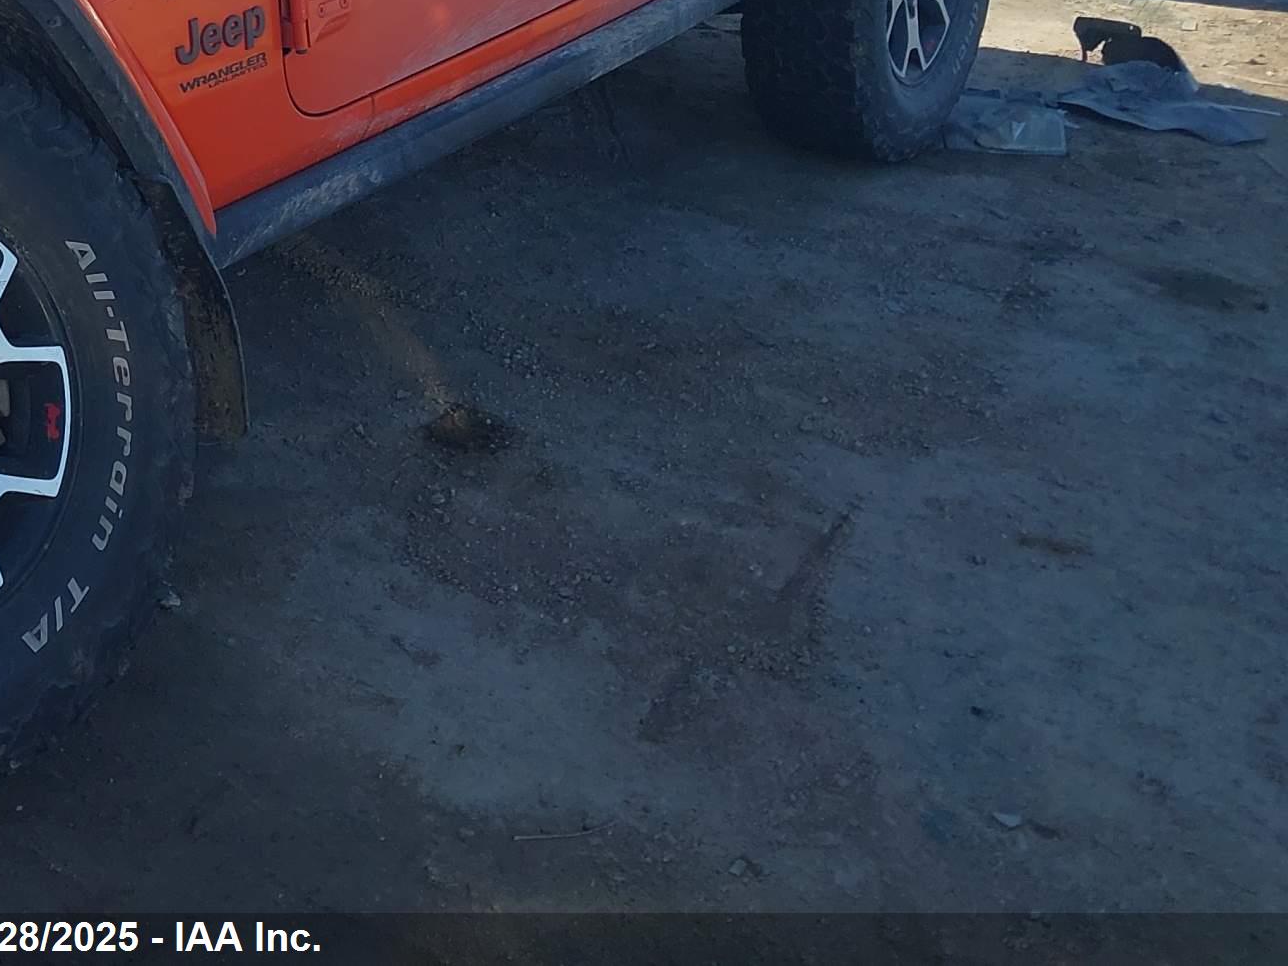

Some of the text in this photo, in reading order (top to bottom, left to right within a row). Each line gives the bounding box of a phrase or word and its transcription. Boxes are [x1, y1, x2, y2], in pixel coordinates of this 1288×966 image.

[175, 5, 266, 66] Jeep
[179, 52, 267, 94] WRANGLER
[65, 240, 133, 552] All-Terrain
